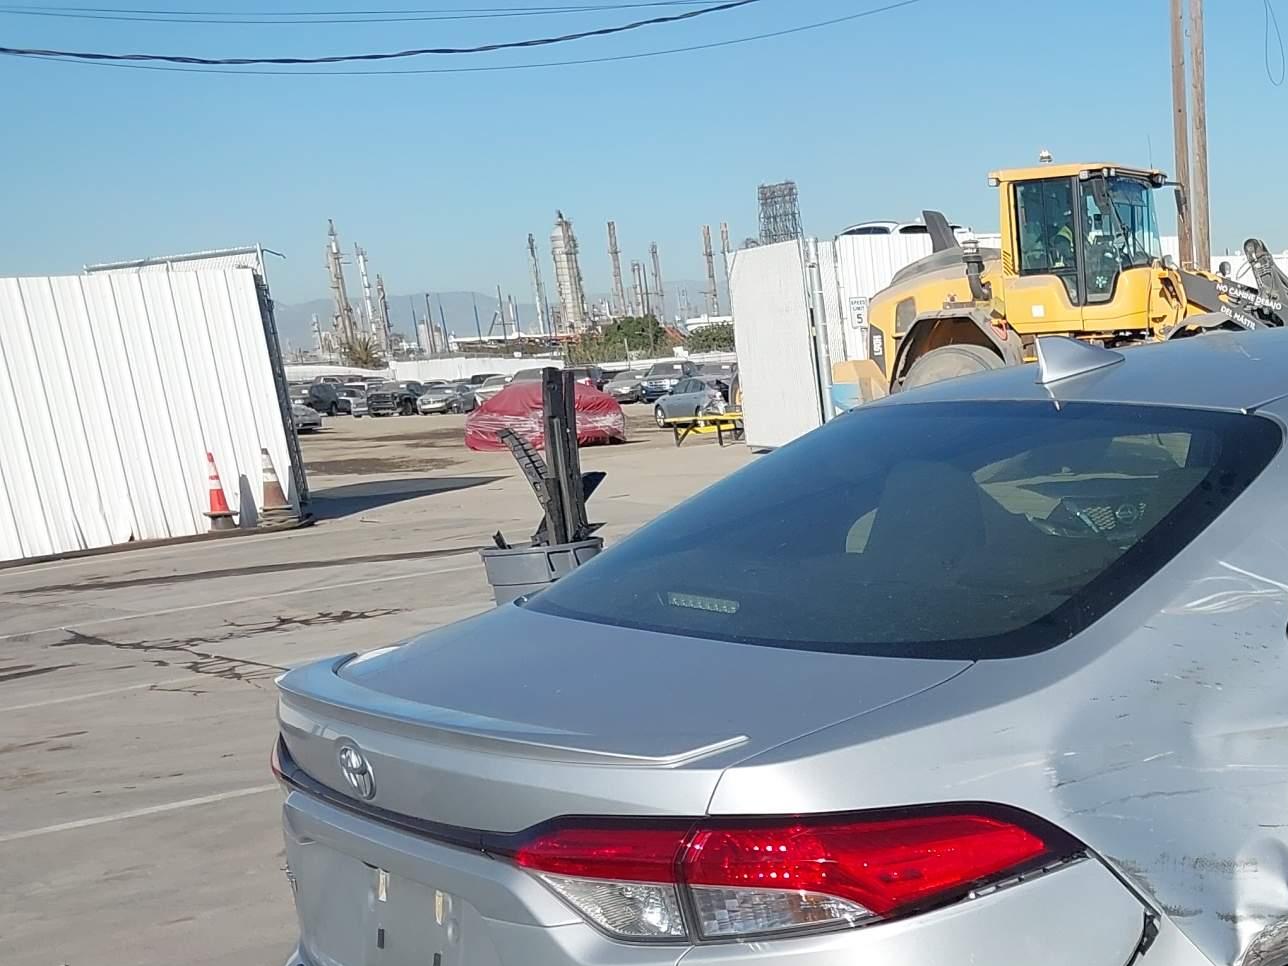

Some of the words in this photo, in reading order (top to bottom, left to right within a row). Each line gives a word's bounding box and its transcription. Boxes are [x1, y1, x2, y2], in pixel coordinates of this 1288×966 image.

[1216, 284, 1228, 292] NO
[1229, 287, 1256, 303] CAMINE
[1221, 305, 1233, 318] DEL
[856, 313, 864, 324] 5
